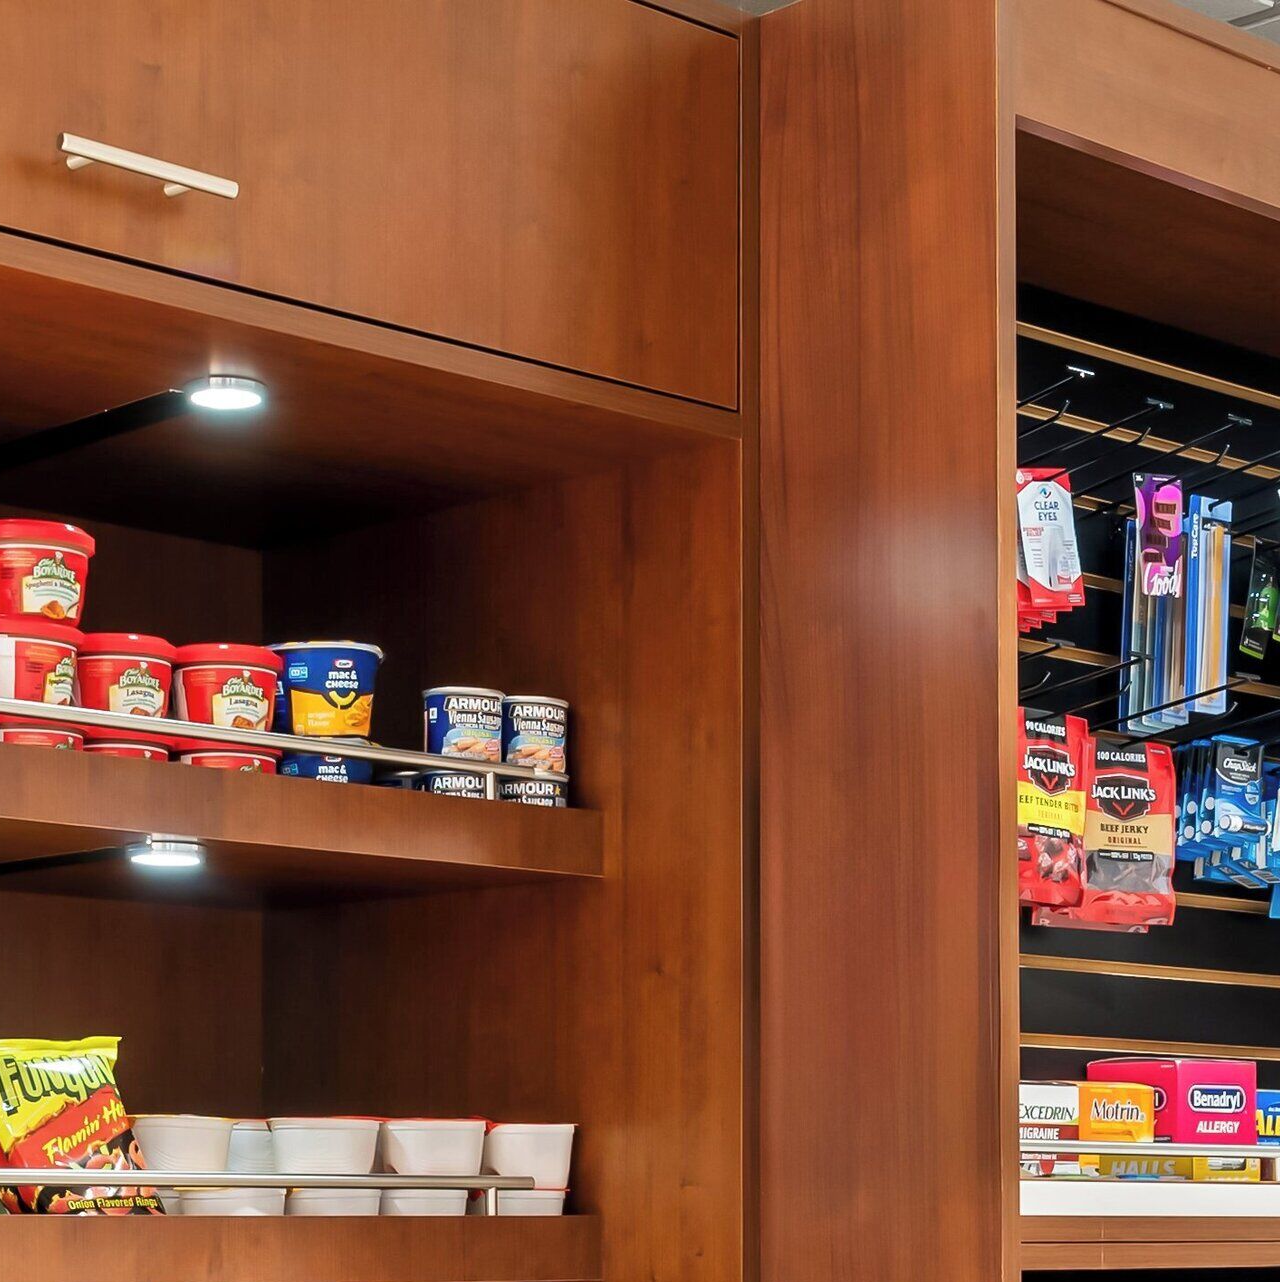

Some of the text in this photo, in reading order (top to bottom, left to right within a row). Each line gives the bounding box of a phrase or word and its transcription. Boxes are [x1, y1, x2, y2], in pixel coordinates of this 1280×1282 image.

[1034, 501, 1060, 511] CLEAR
[1038, 512, 1058, 521] EYES
[1035, 721, 1066, 737] CALORIES
[1023, 754, 1048, 773] JACK
[1097, 751, 1146, 764] 100 CALORIES
[434, 777, 484, 789] ARMOU
[1092, 784, 1157, 801] JACK LINK'S
[1019, 794, 1034, 804] EEF
[1035, 795, 1062, 810] TENDER
[1100, 823, 1149, 834] BEEF JERKY
[1107, 835, 1142, 845] ORIGINAL
[1193, 1090, 1241, 1111] Benadryl
[1090, 1098, 1141, 1121] Motrin
[1196, 1120, 1241, 1134] ALLERGY
[68, 1198, 96, 1210] Onion
[96, 1197, 134, 1208] Flavored
